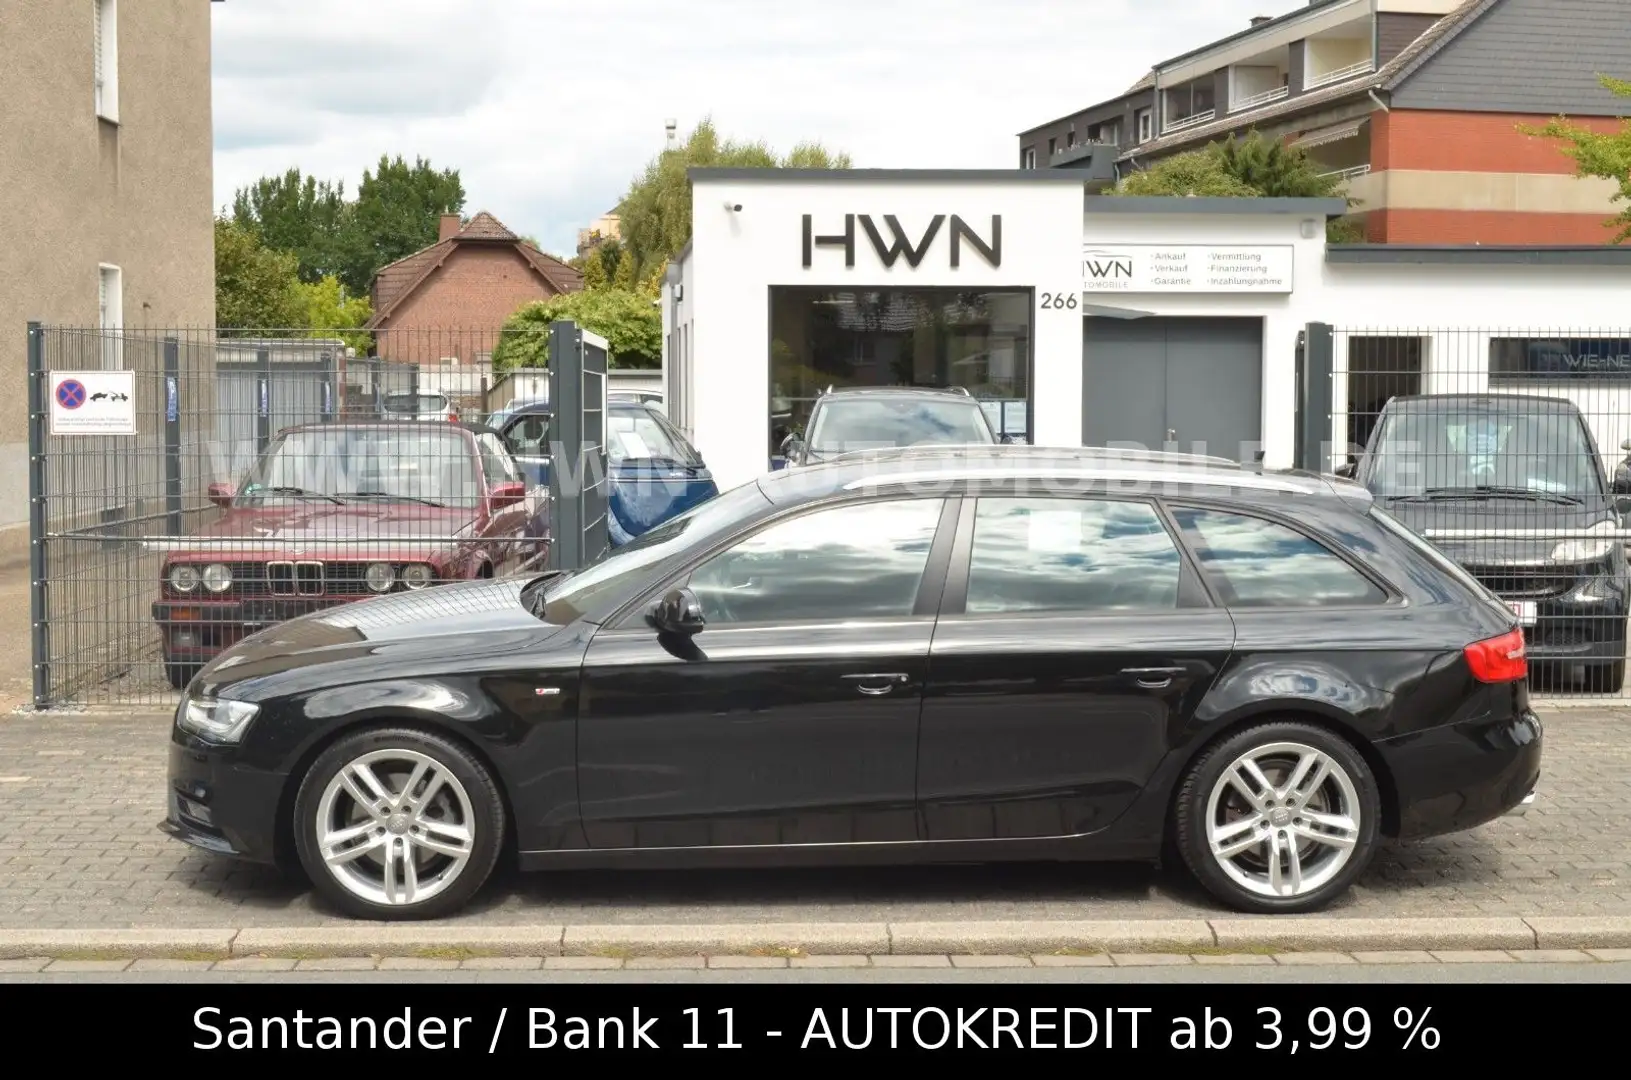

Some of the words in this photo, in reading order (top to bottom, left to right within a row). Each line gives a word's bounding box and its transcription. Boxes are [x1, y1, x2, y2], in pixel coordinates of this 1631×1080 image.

[802, 214, 1002, 268] HWN
[1154, 252, 1186, 261] Ankauf
[1211, 252, 1262, 262] Vermittlung
[1082, 260, 1132, 278] WN
[1154, 264, 1188, 273] Verkauf
[1210, 264, 1268, 274] Finanzierung
[1154, 277, 1191, 285] Garantie
[1210, 277, 1283, 287] Inzahlungnahme
[1040, 292, 1078, 310] 266
